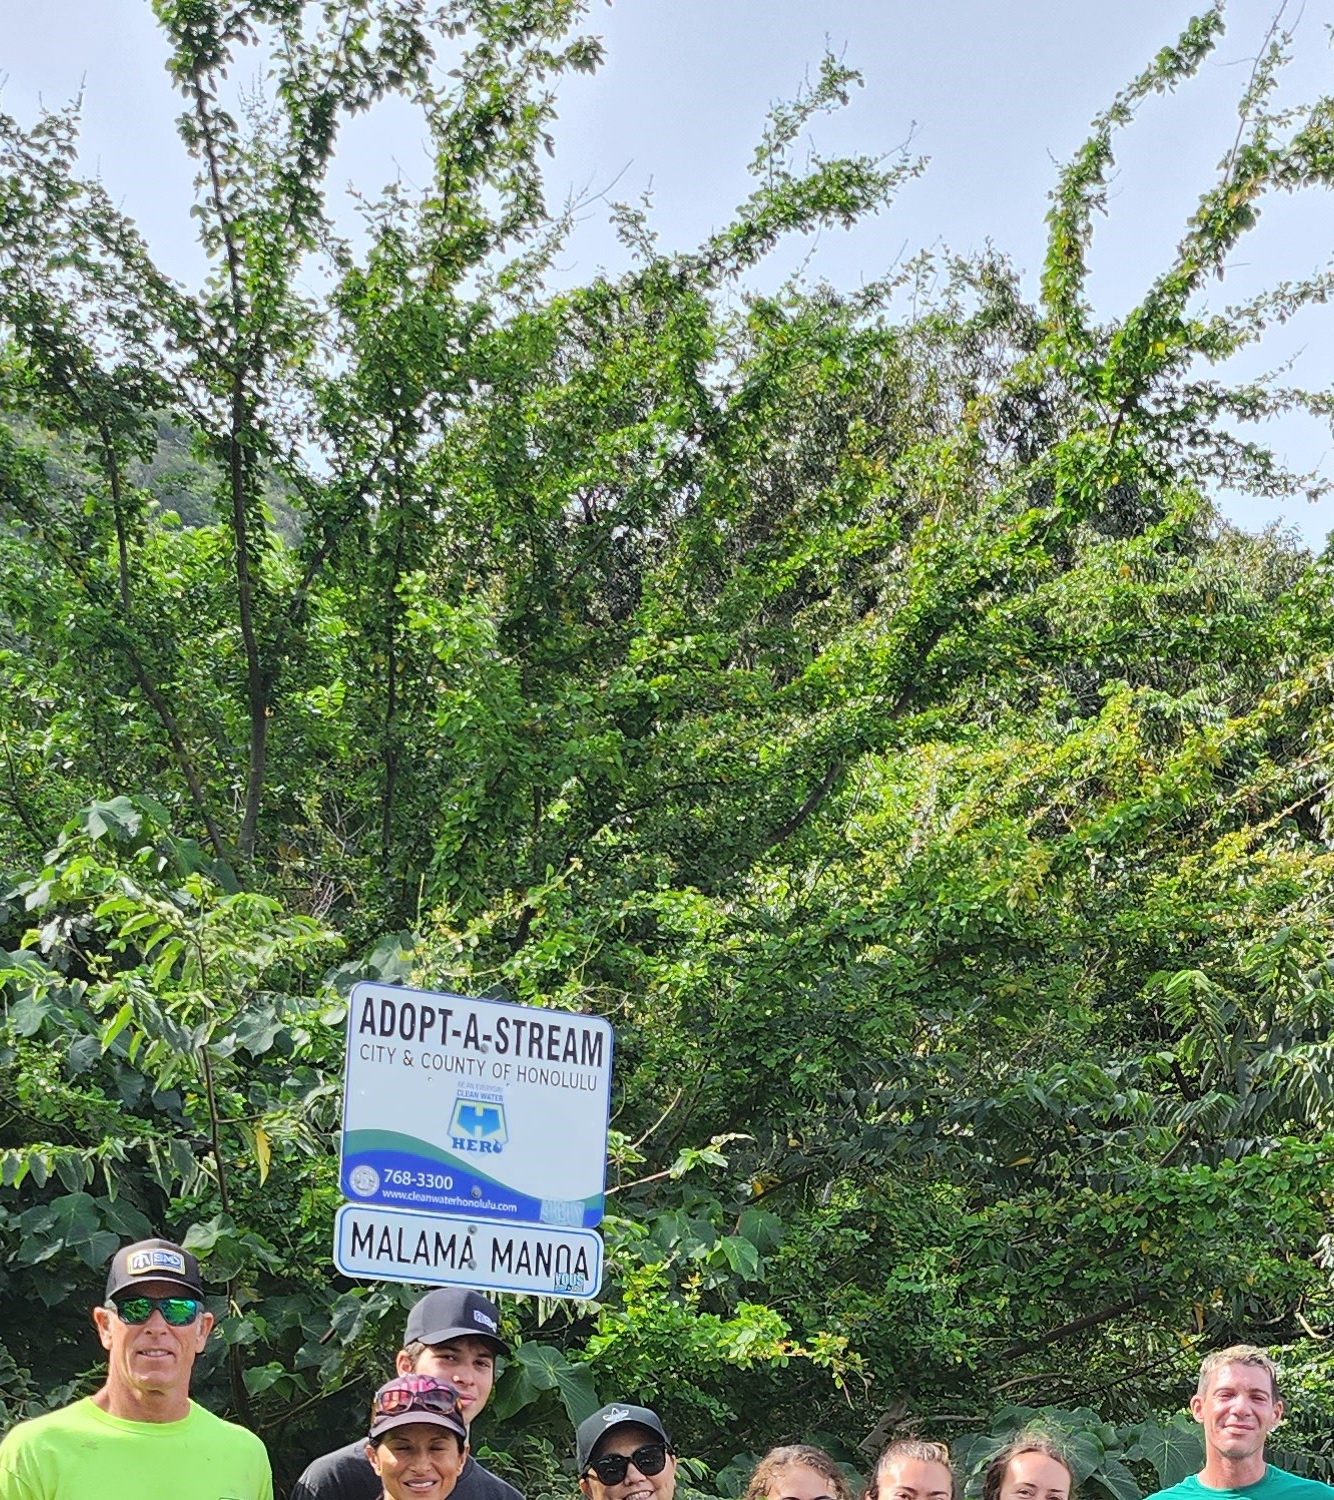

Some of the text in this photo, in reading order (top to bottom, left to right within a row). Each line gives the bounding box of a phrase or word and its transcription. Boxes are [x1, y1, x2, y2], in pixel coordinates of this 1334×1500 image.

[359, 997, 604, 1068] ADOPT-A-STREAM
[359, 1044, 598, 1092] CITY & COUNTY OF HONOLULU
[457, 1089, 504, 1102] CLEAN WATER
[383, 1168, 454, 1190] 768-3300
[382, 1189, 518, 1213] www.cleanwaterhonolulu.com
[491, 1236, 590, 1281] MANOA
